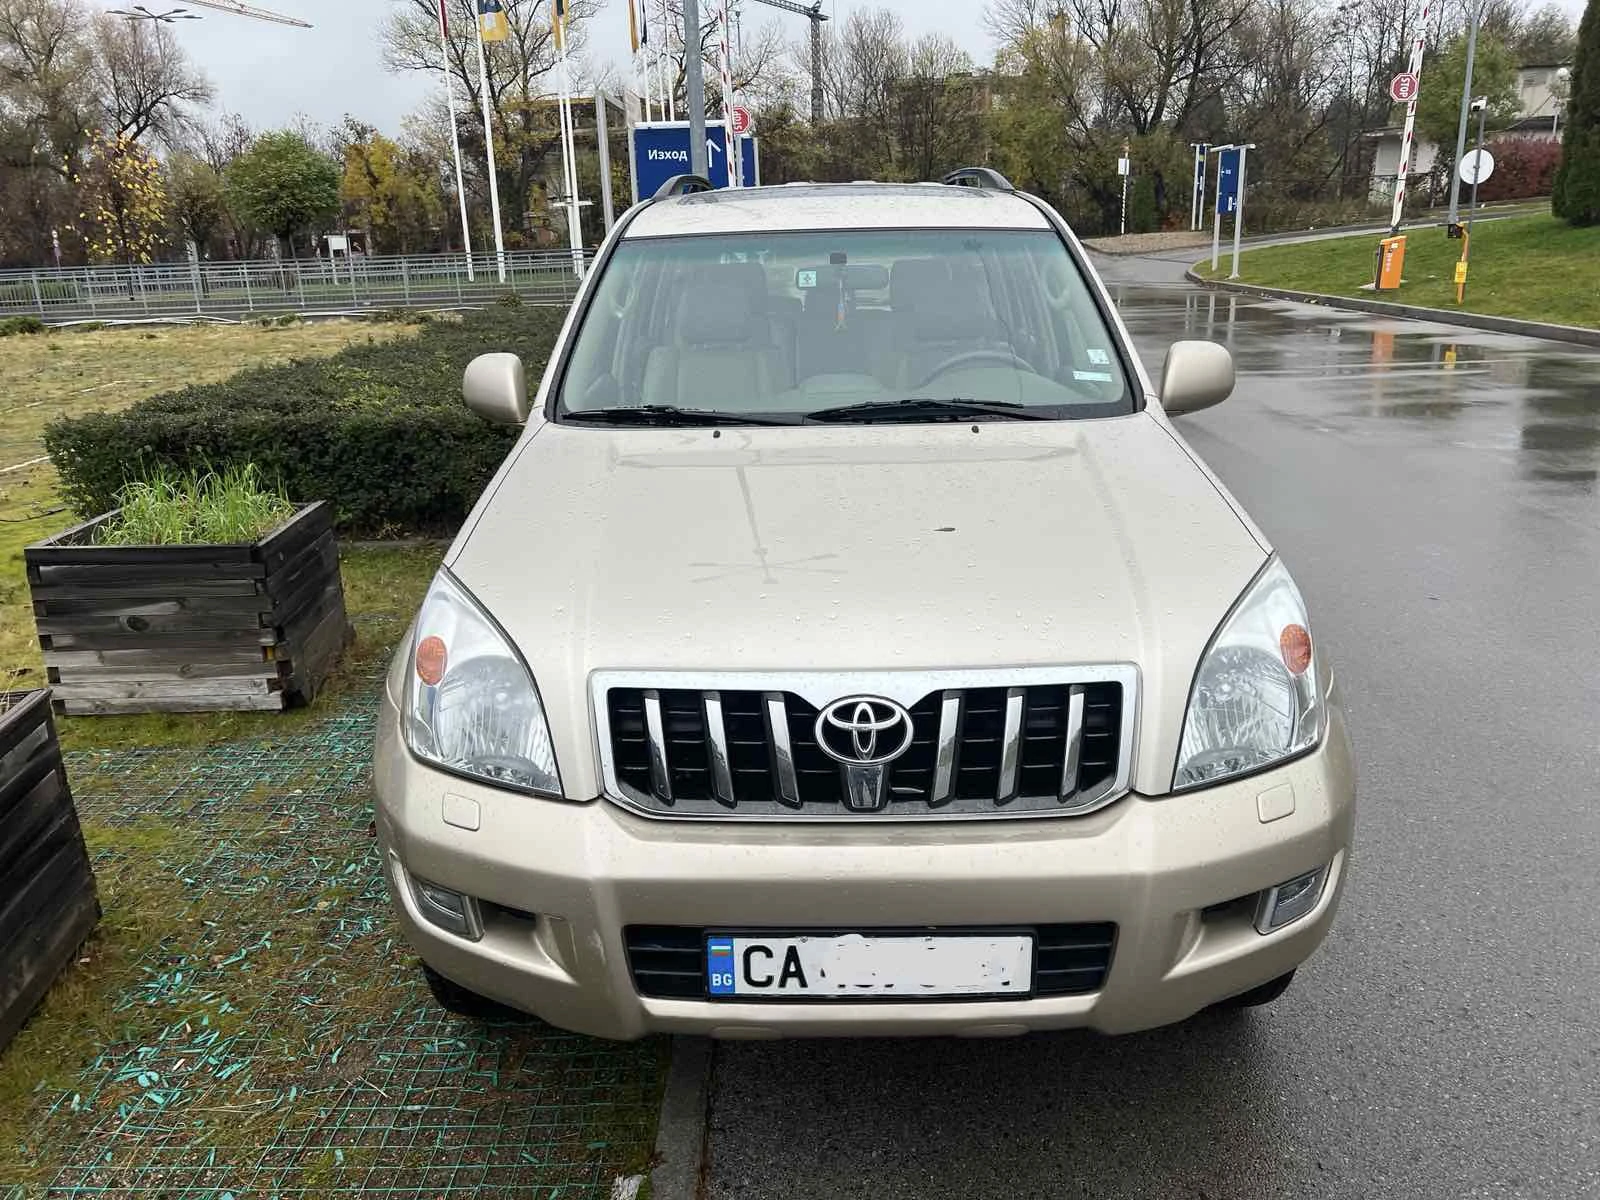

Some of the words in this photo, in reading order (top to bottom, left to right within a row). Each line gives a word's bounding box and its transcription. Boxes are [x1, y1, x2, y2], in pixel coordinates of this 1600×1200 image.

[1400, 77, 1410, 97] STOP
[648, 149, 688, 162] Изход
[743, 945, 808, 988] CA
[712, 973, 732, 986] BG
